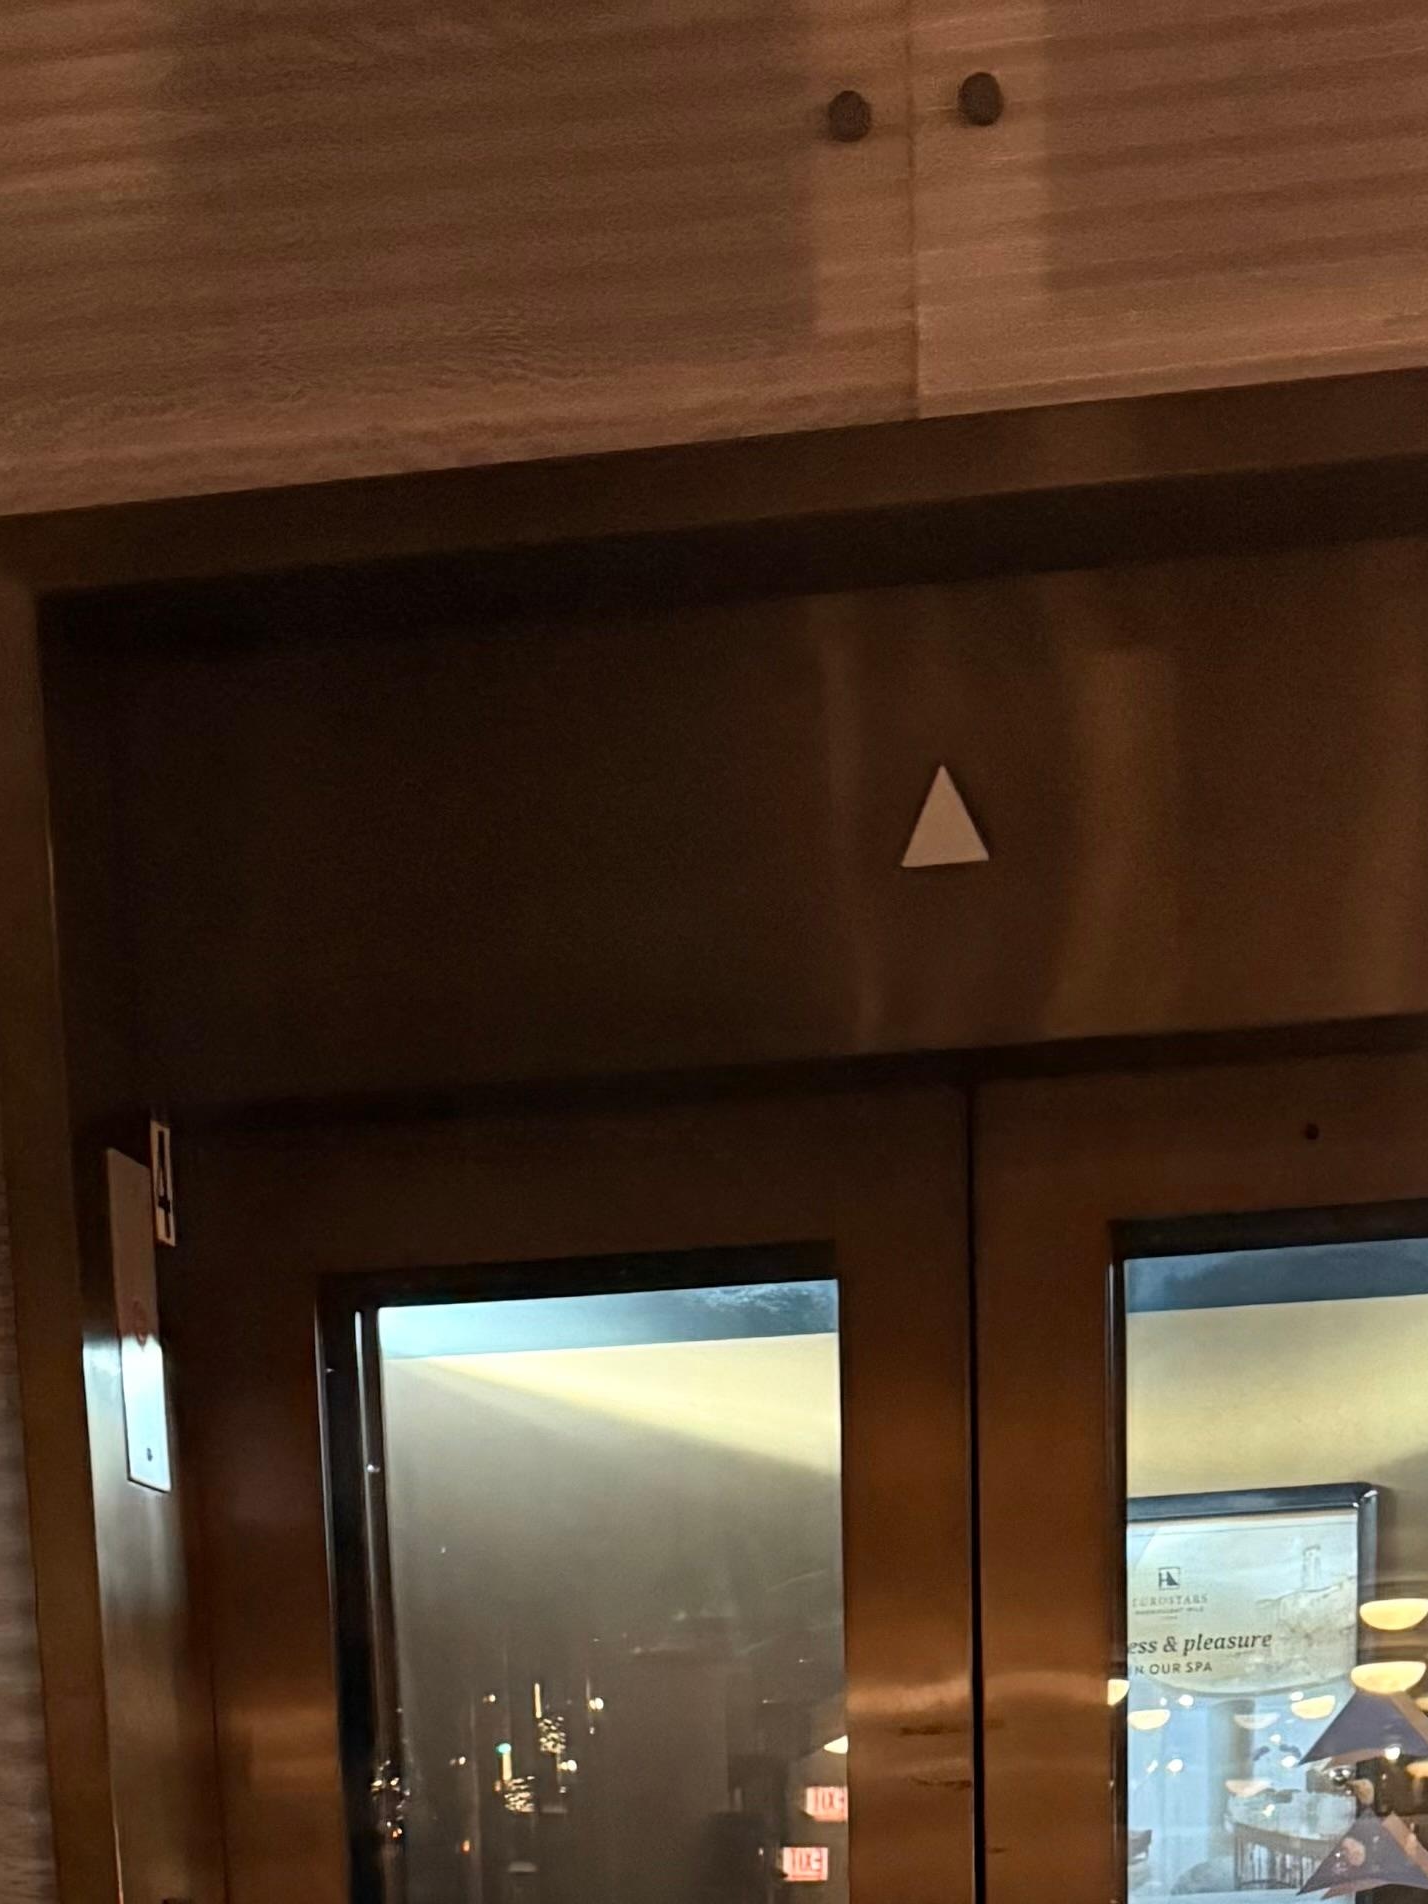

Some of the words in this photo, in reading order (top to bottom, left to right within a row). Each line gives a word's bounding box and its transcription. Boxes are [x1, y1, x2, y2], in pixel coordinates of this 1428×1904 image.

[1128, 1639, 1158, 1655] ess
[1163, 1635, 1177, 1654] &
[1182, 1632, 1273, 1657] pleasure
[1149, 1663, 1181, 1676] OUR
[1185, 1660, 1213, 1674] SPA
